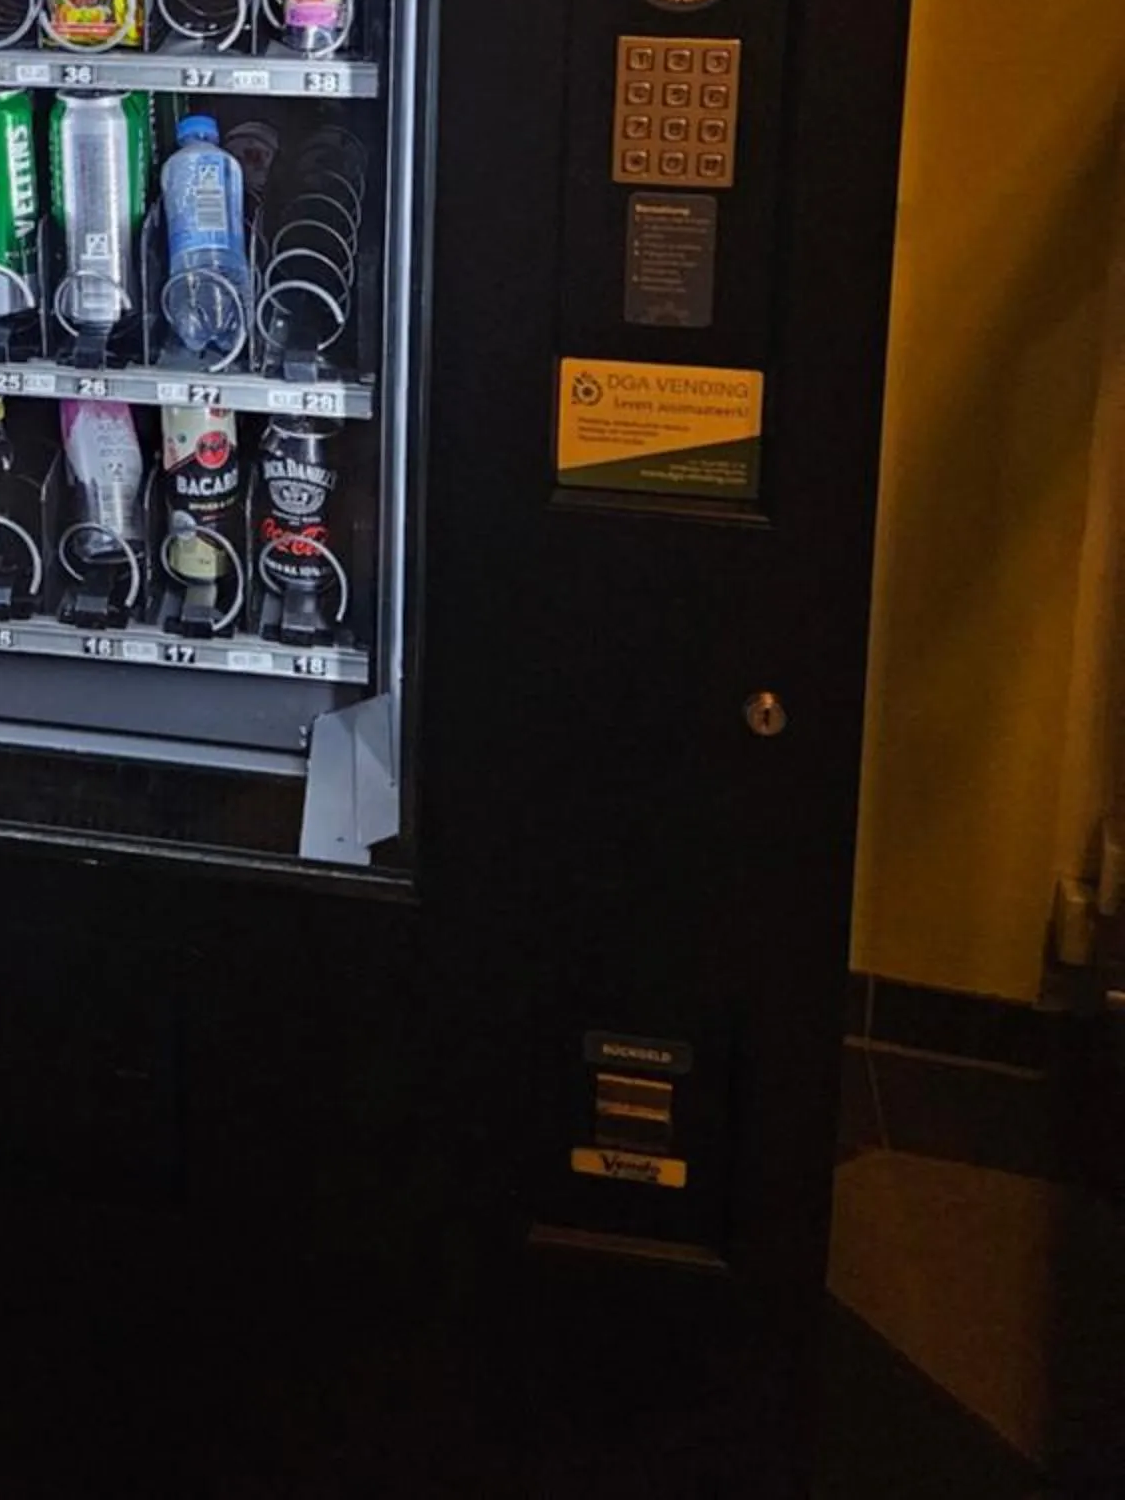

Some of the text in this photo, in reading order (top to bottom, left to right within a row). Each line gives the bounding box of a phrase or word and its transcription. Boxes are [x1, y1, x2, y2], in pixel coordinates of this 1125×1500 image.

[65, 66, 92, 83] 36
[187, 68, 214, 86] 37
[307, 73, 336, 91] 38
[7, 123, 36, 239] VELTINS
[79, 378, 106, 395] 26
[191, 386, 219, 404] 27
[607, 373, 748, 399] DGA VENDING
[85, 638, 112, 656] 16
[167, 646, 195, 663] 17
[295, 656, 324, 675] 18
